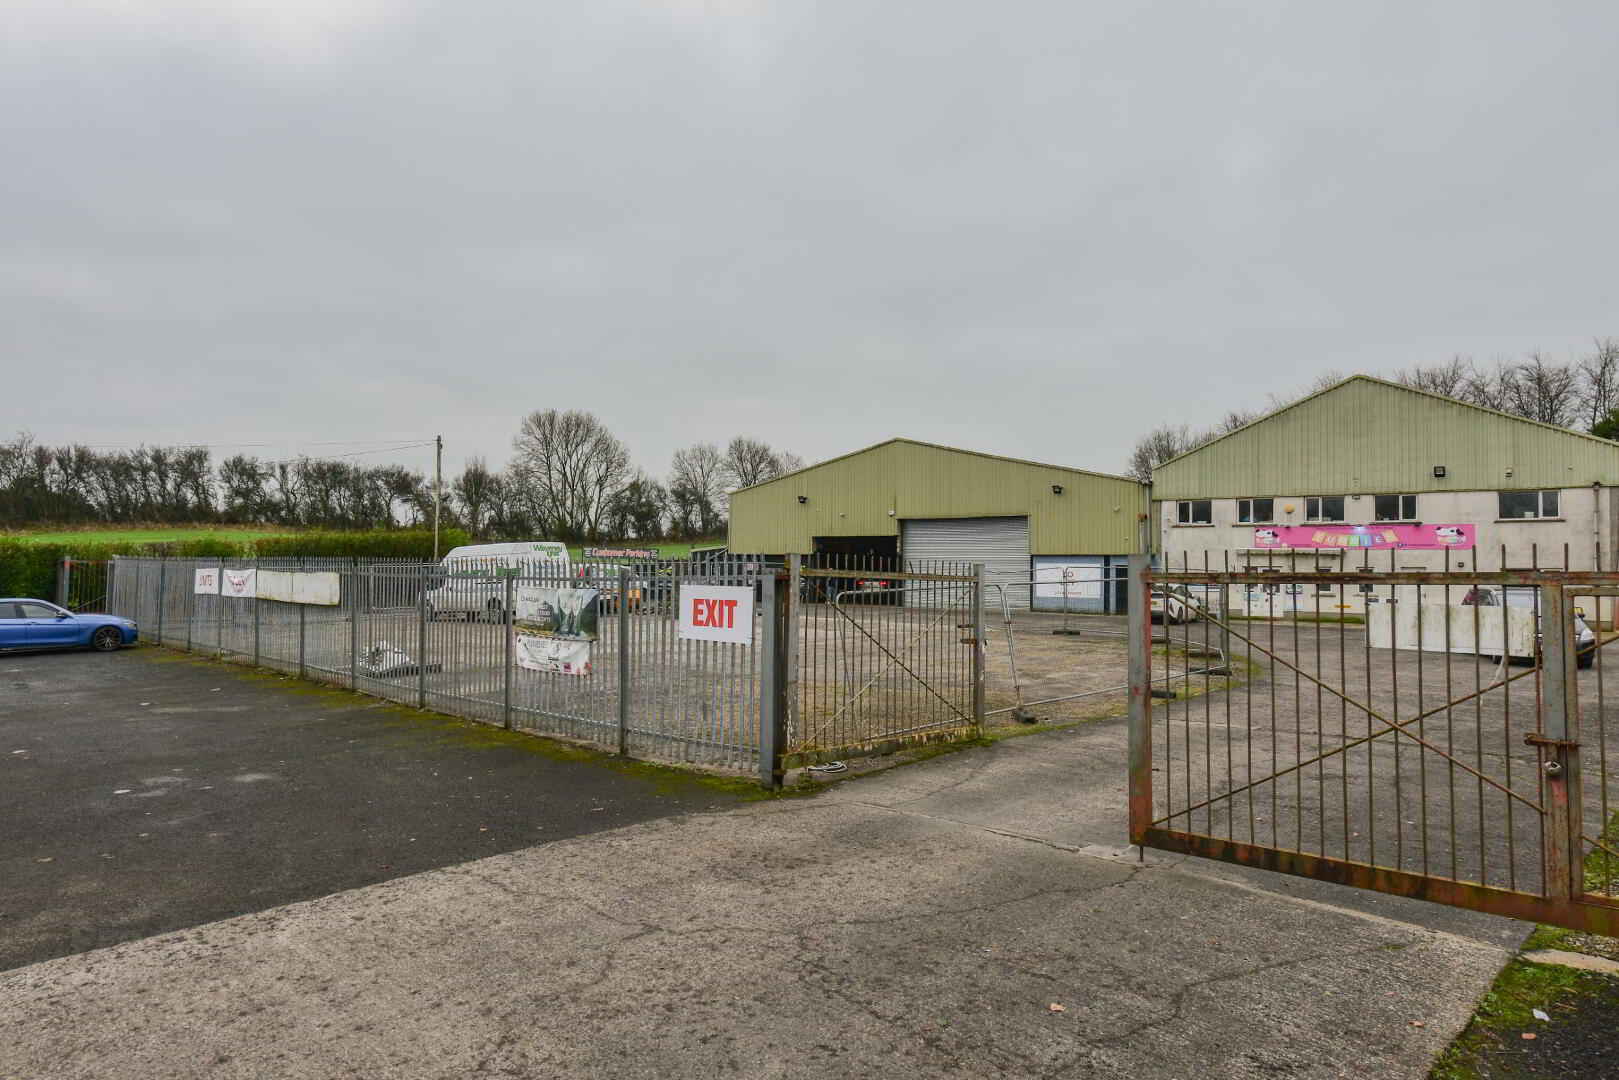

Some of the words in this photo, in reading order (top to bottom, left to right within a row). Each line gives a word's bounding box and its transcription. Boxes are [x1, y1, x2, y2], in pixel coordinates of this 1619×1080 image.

[532, 544, 563, 553] Waveney
[592, 547, 625, 557] Customer
[625, 548, 652, 559] Parking
[692, 598, 737, 629] EXIT
